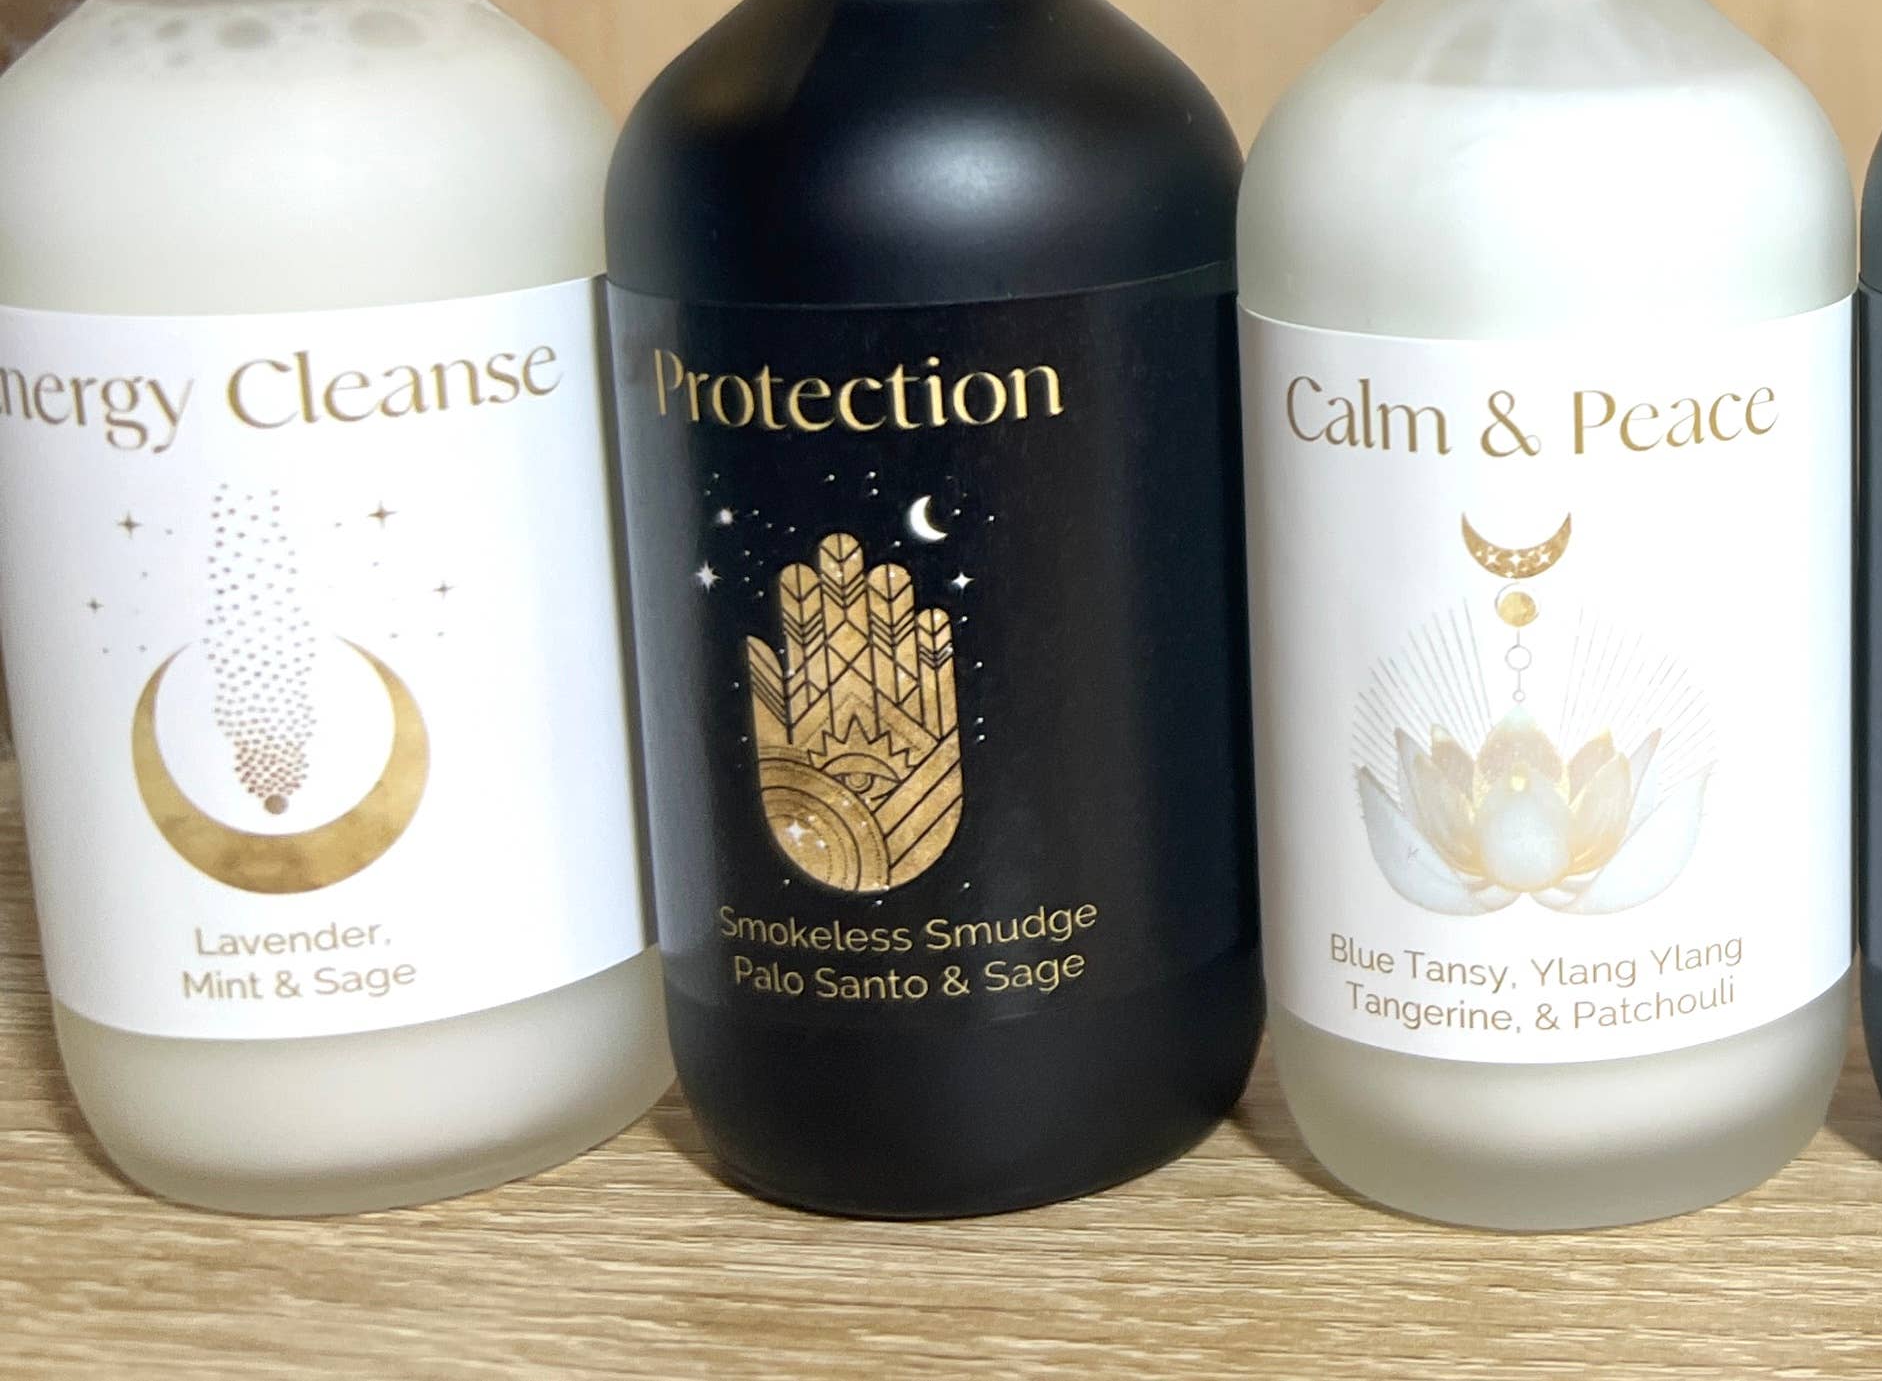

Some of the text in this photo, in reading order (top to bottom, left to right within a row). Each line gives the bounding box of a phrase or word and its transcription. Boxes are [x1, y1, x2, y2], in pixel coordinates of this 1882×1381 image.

[0, 344, 561, 454] nergy Cleanse
[654, 348, 1065, 432] Protection
[1286, 375, 1780, 458] Calm & Peace
[196, 922, 392, 957] Lavender,
[719, 901, 1098, 952] Smokeless Smudge
[181, 961, 417, 1000] Mint & Sage
[734, 952, 1086, 1000] Palo Santo & Sage
[1331, 934, 1743, 994] Blue Tansy, Ylang Ylang
[1346, 976, 1735, 1033] Tangerine, & Patchouli
